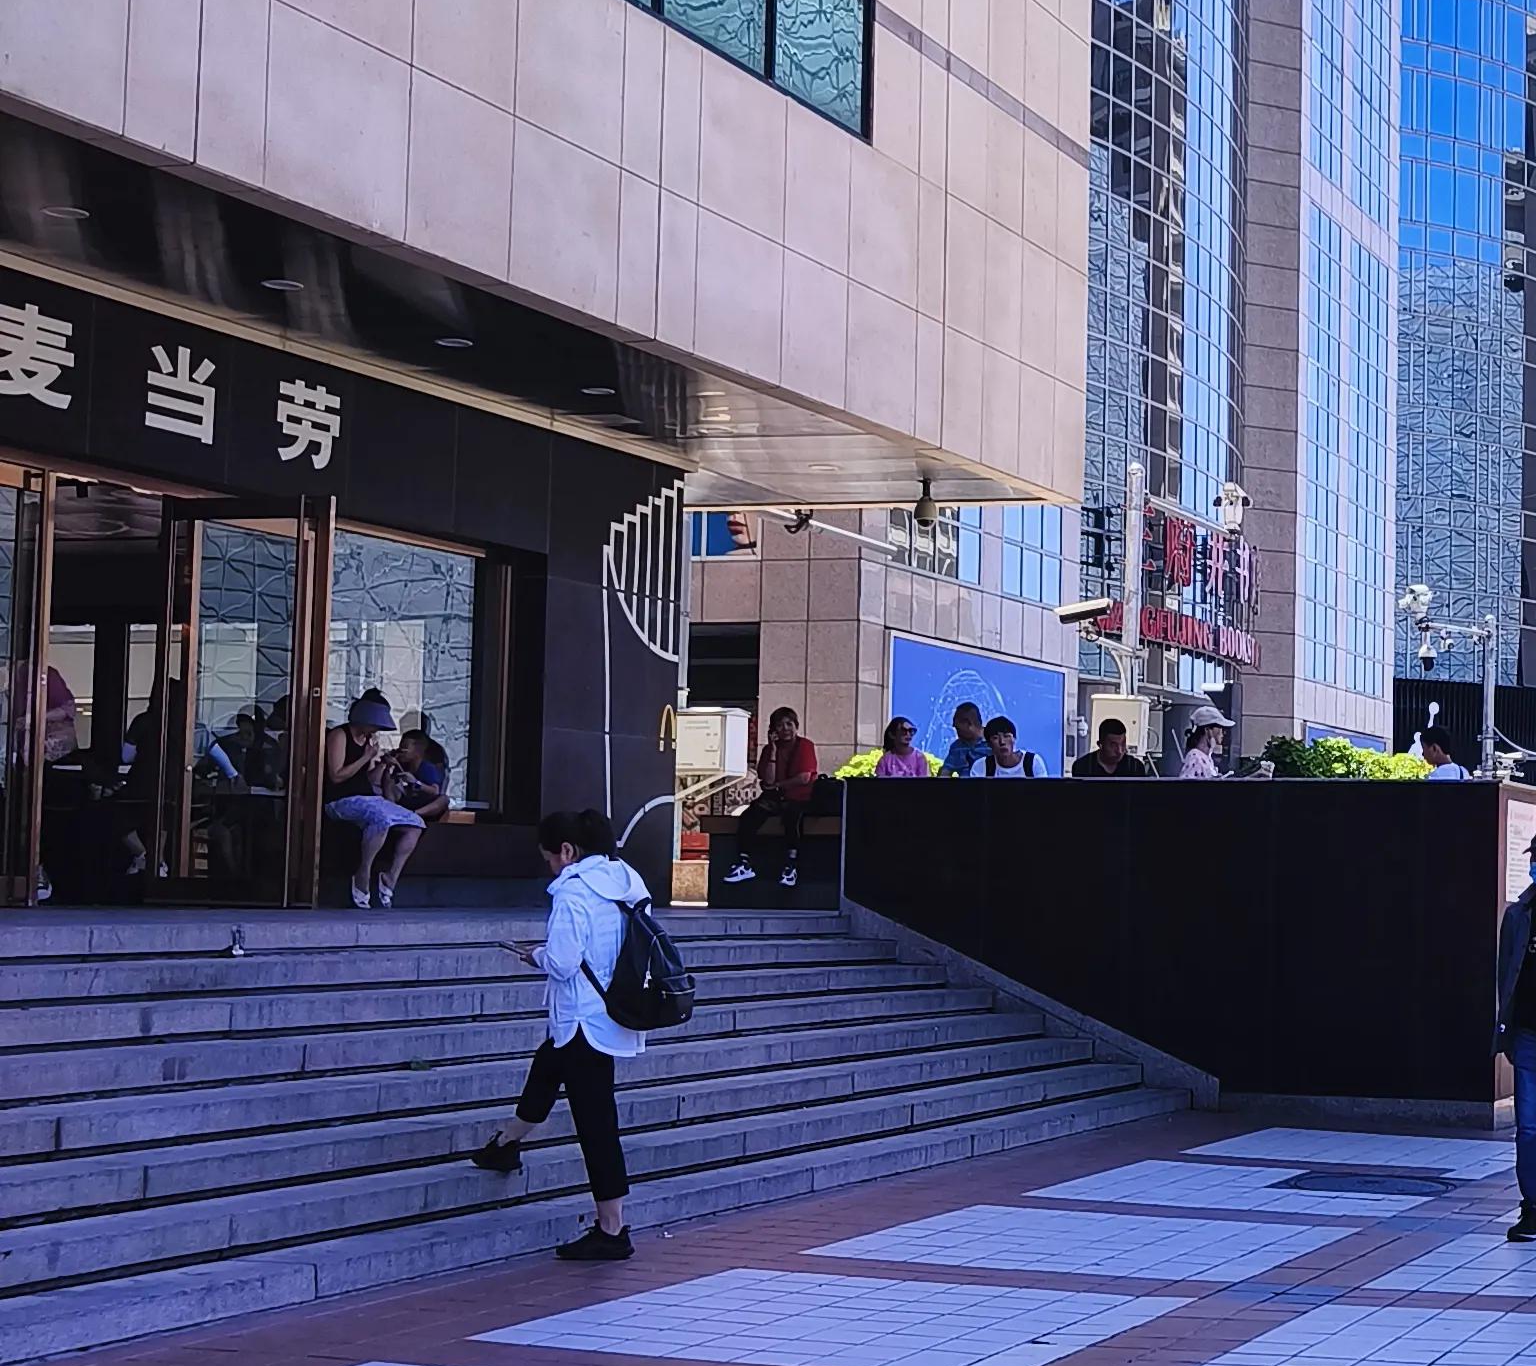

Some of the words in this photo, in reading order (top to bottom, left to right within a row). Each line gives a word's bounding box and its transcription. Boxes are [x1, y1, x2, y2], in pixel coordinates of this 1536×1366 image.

[0, 302, 341, 470] 麦当劳
[1096, 600, 1214, 651] AGFUJING
